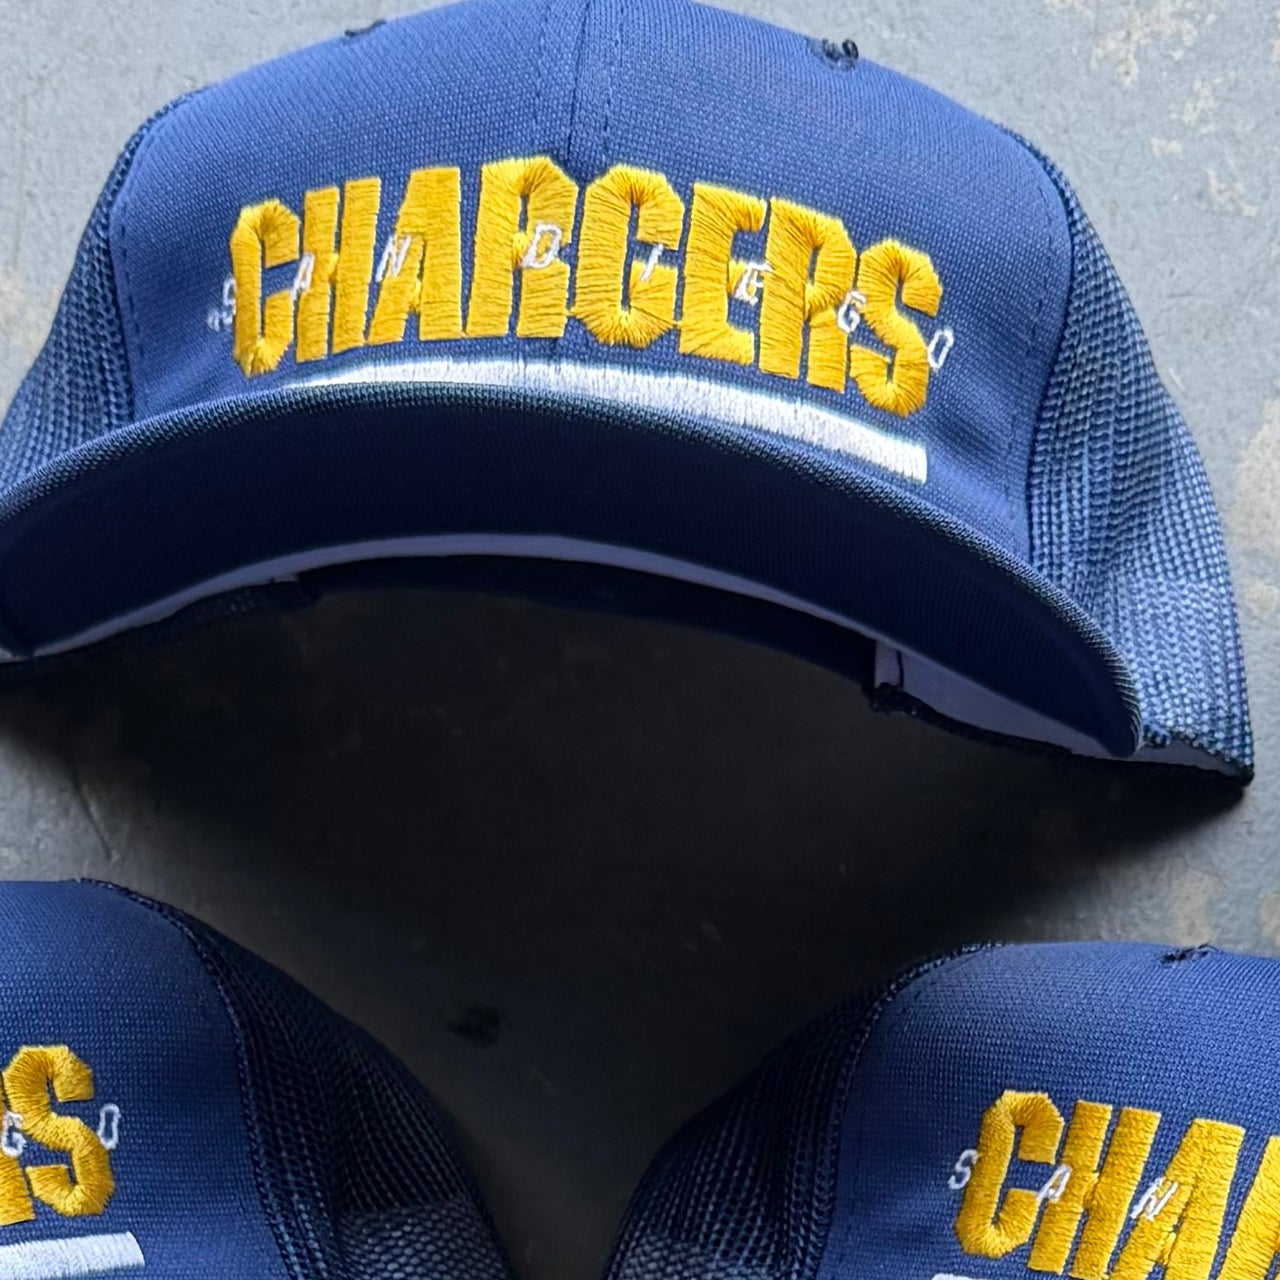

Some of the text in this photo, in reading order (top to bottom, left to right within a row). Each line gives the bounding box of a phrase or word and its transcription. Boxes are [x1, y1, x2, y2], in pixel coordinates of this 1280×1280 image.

[222, 223, 955, 369] SAN DIEGO
[228, 155, 945, 419] CHARGERS
[948, 1149, 1177, 1222] SAN
